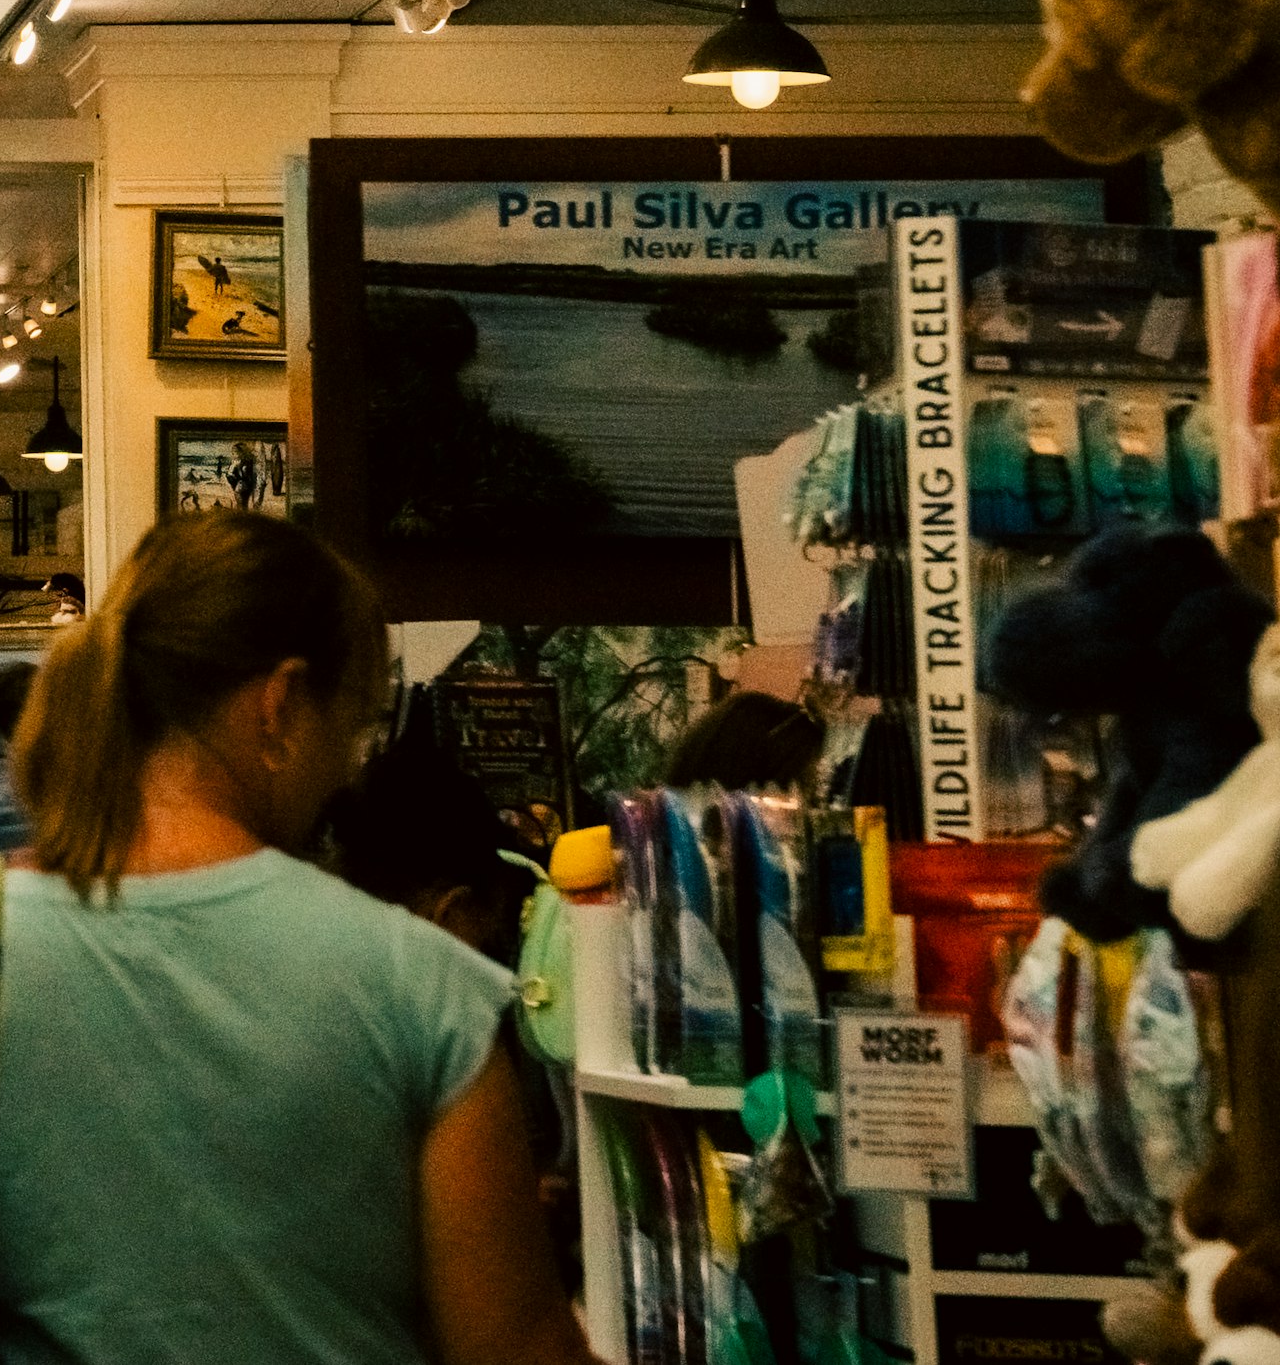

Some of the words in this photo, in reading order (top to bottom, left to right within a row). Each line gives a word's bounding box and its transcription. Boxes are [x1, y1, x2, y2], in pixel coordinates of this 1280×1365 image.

[497, 190, 612, 230] Paul
[633, 190, 764, 231] Silva
[623, 236, 693, 260] New
[705, 236, 757, 260] Era
[769, 236, 818, 260] Art
[910, 228, 953, 450] BRACELETS
[920, 466, 963, 674] TRACKING
